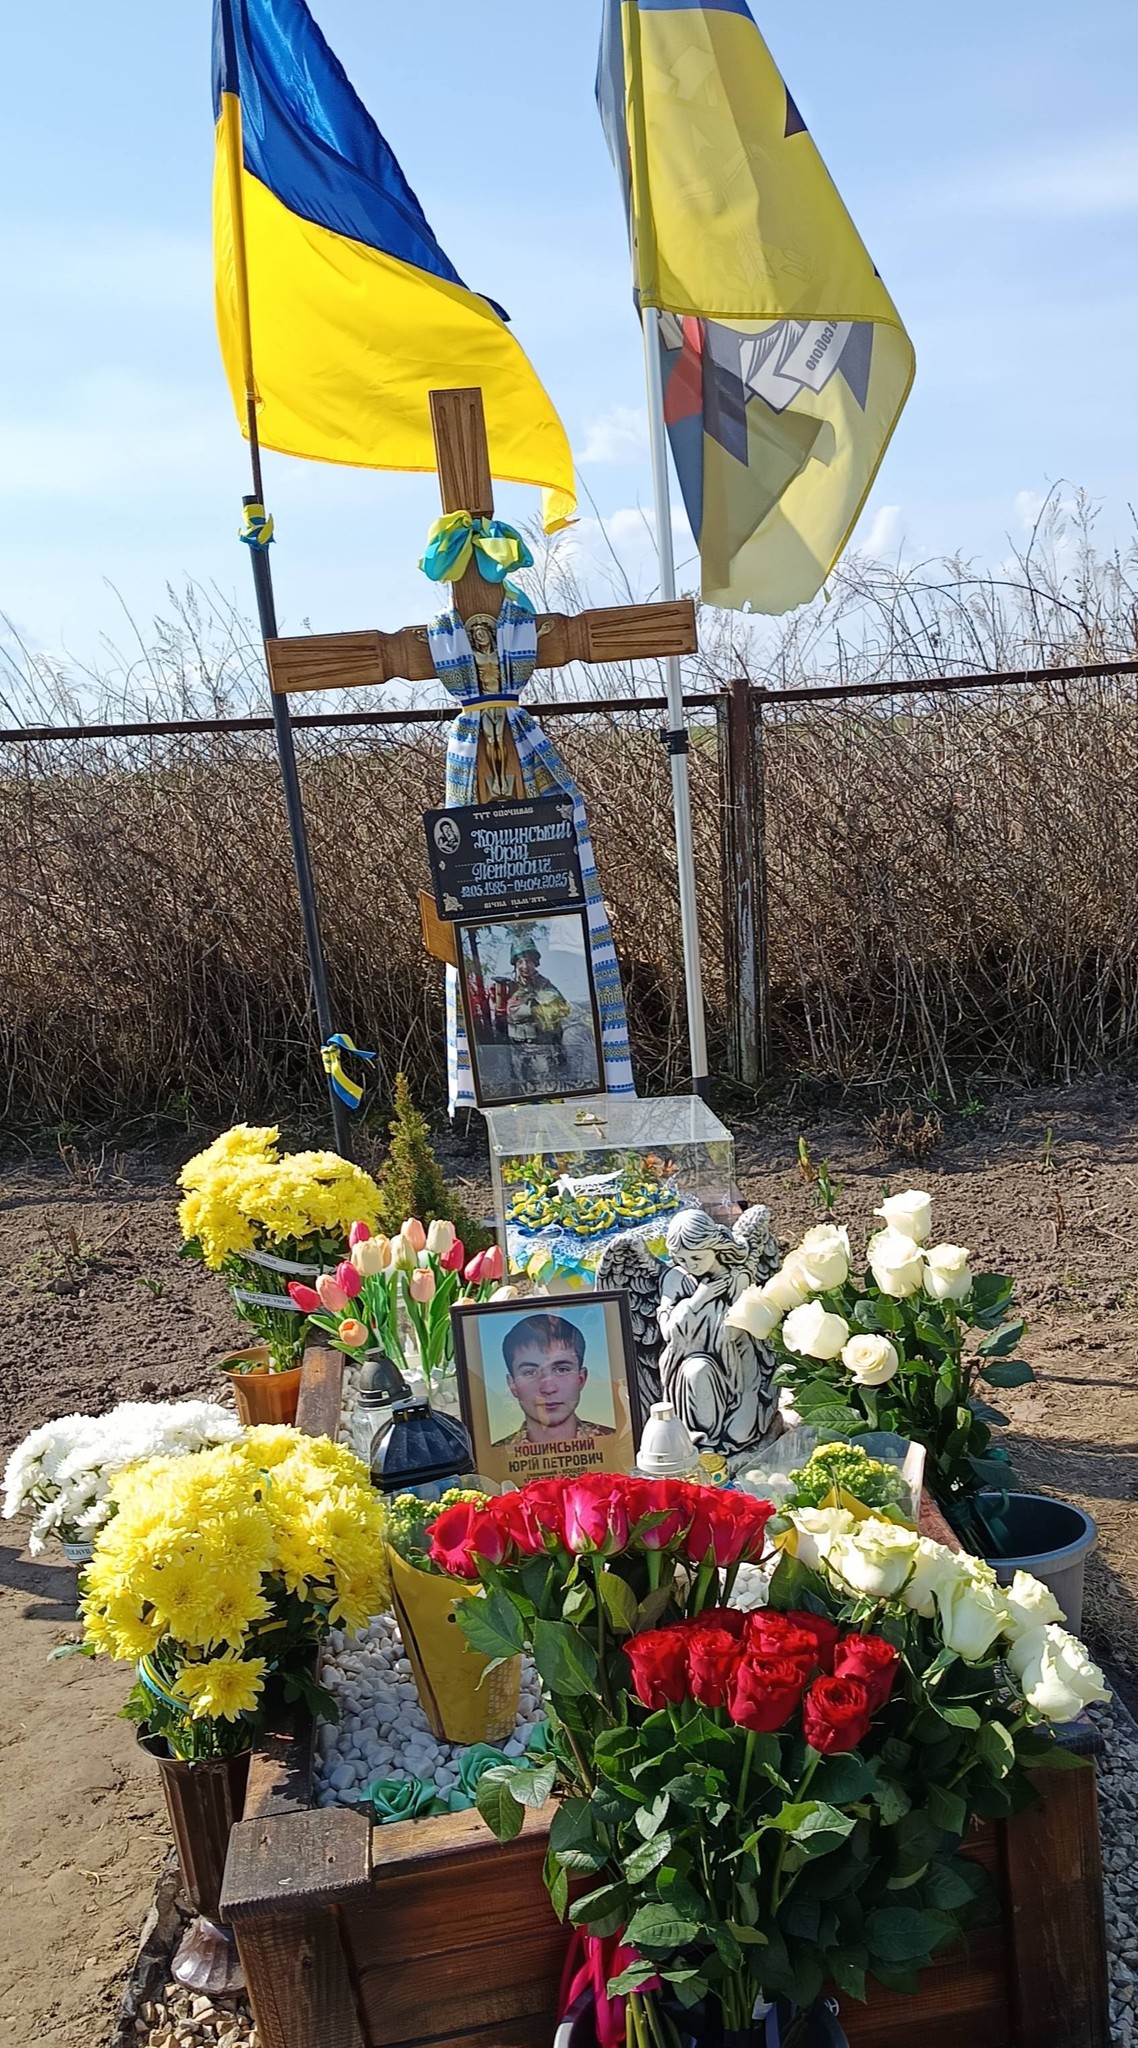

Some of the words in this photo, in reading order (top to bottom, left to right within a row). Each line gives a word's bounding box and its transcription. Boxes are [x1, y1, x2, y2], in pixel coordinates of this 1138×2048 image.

[473, 812, 491, 820] ТУТ
[471, 821, 572, 849] Кошинський
[514, 1438, 595, 1458] КОШИНСЬКИЙ
[508, 1458, 540, 1473] ЮРІЙ
[543, 1452, 604, 1469] ПЕТРОВИЧ
